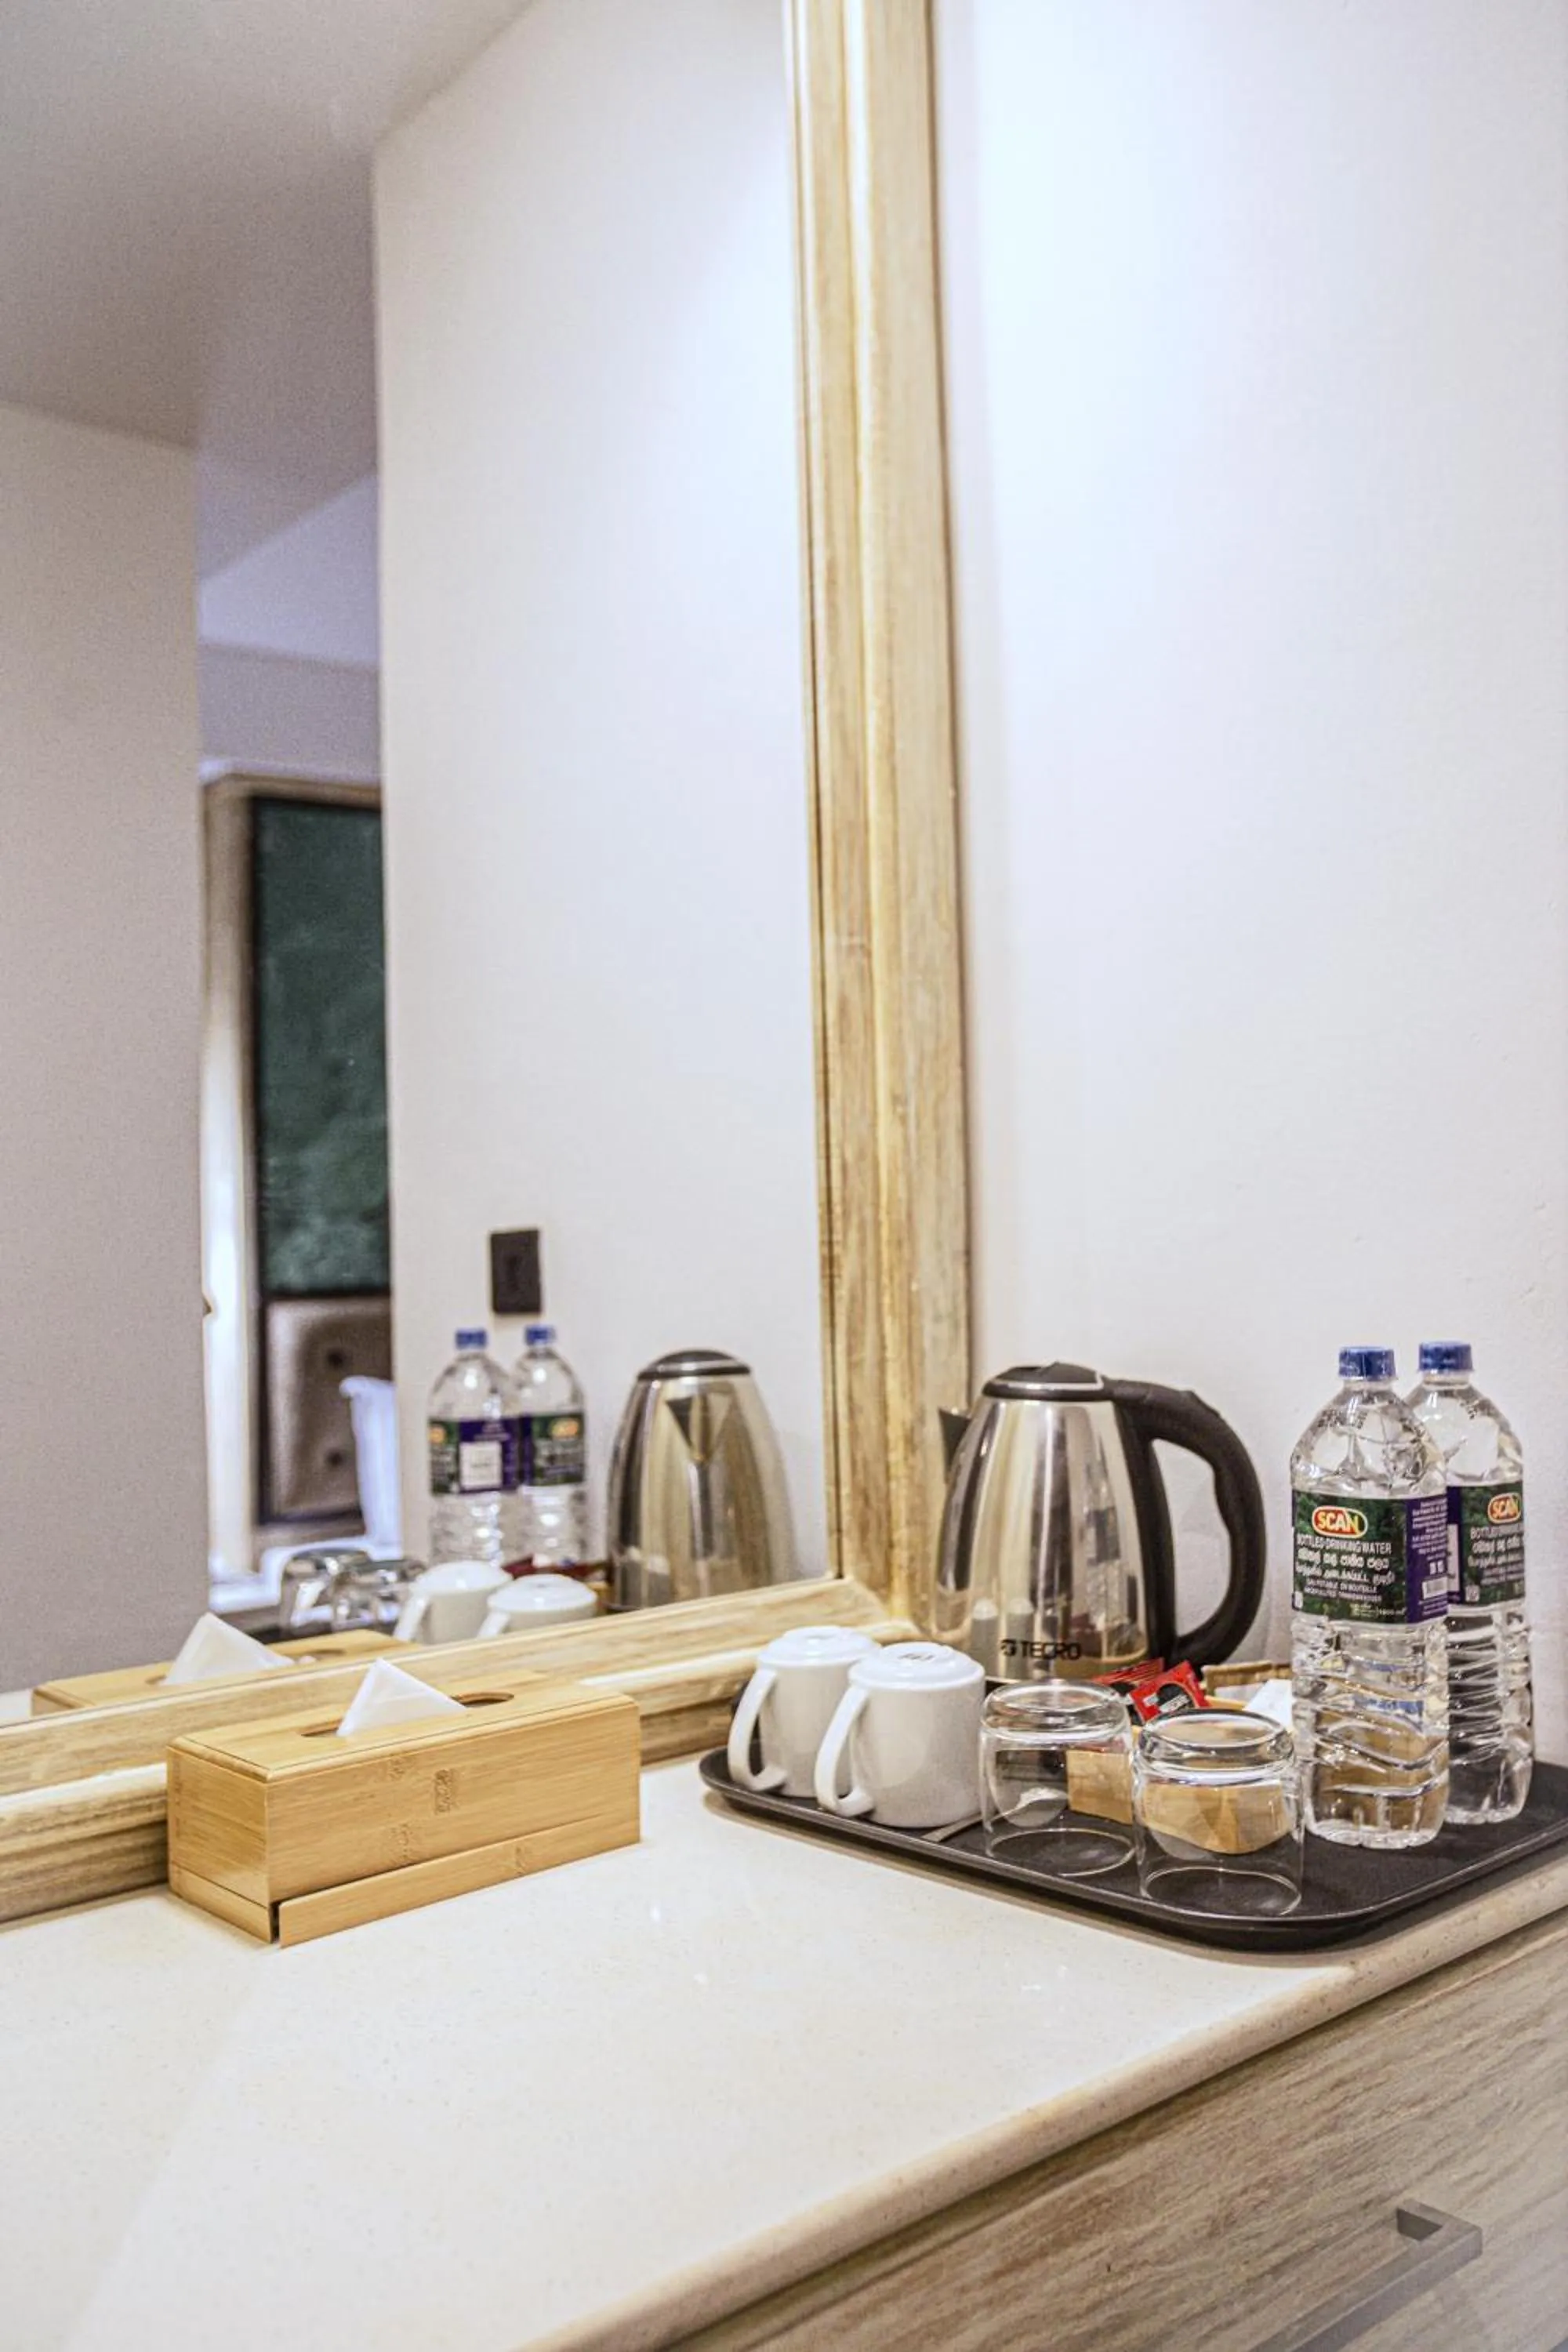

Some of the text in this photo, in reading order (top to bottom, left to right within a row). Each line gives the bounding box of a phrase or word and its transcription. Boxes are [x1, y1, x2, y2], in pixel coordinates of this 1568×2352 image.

[1491, 1497, 1519, 1519] SCAN
[1317, 1511, 1359, 1534] SCAN
[1362, 1541, 1392, 1555] WATER
